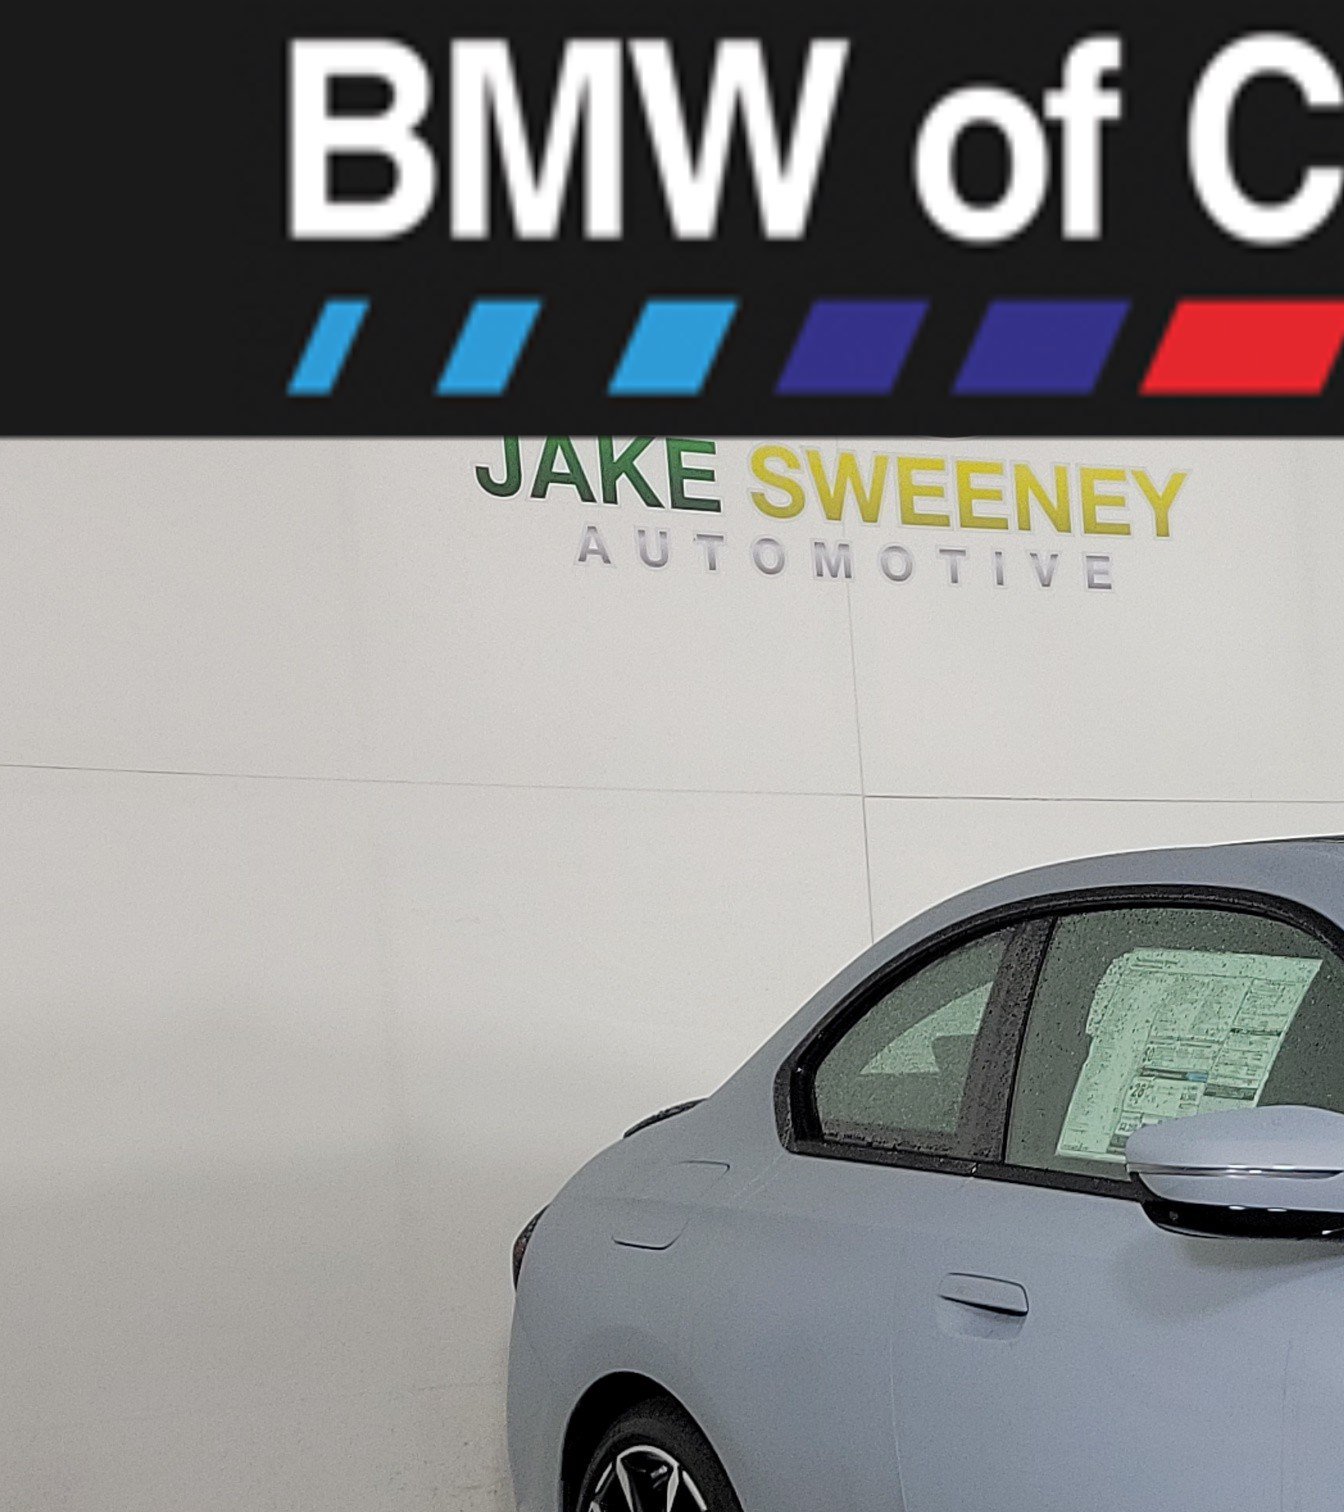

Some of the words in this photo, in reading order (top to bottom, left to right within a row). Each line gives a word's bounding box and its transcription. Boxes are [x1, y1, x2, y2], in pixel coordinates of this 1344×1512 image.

[474, 436, 723, 513] JAKE
[750, 444, 1188, 538] SWEENEY
[576, 525, 1113, 591] AUTOMOTIVE
